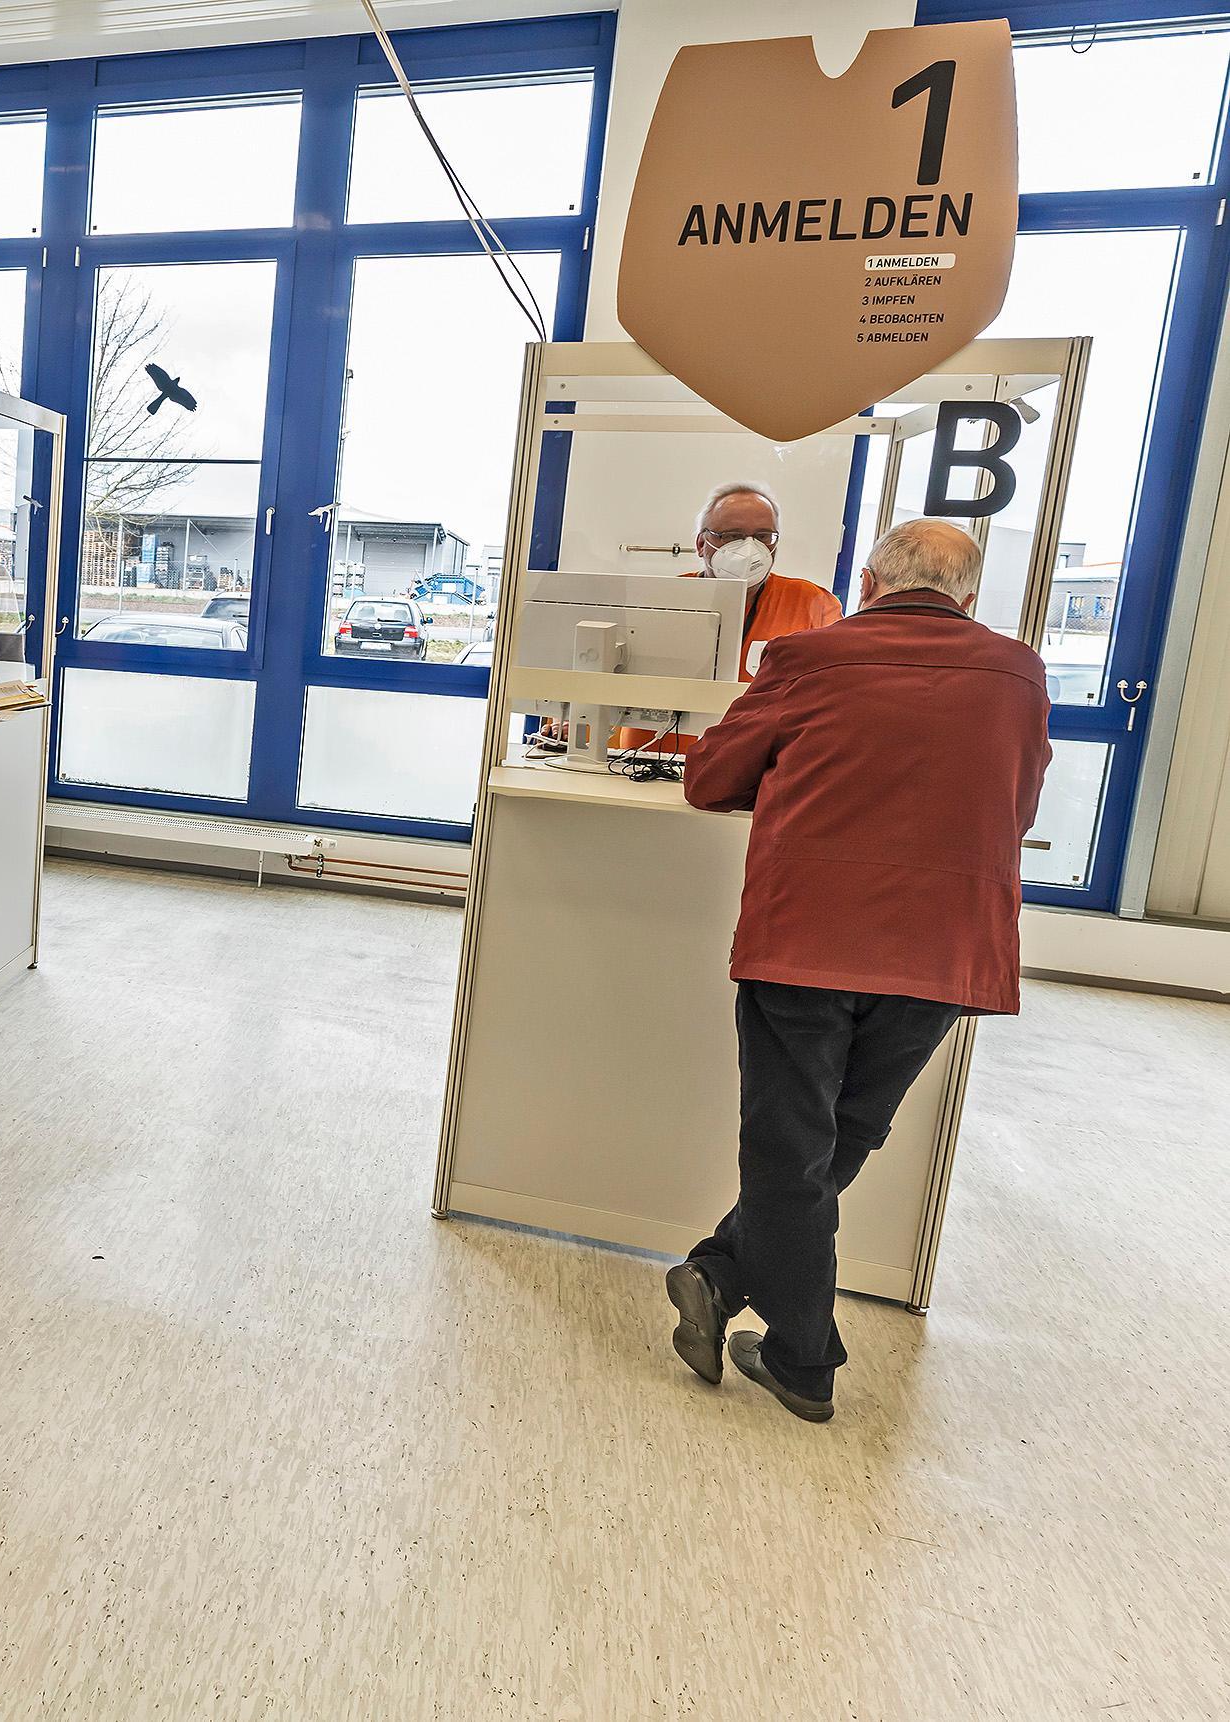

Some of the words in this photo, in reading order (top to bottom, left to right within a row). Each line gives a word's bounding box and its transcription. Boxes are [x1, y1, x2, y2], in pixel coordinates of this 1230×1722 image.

[891, 60, 957, 186] 1
[677, 193, 974, 246] ANMELDEN
[868, 259, 873, 268] 1
[876, 257, 940, 268] ANMELDEN
[865, 278, 872, 287] 2
[874, 274, 942, 287] AUFKLÄREN
[862, 296, 869, 305] 3
[872, 295, 916, 305] IMPFEN
[859, 315, 867, 324] 4
[870, 313, 945, 324] BEOBACHTEN
[856, 333, 864, 342] 5
[866, 332, 929, 342] ABMELDEN
[923, 401, 1021, 518] B
